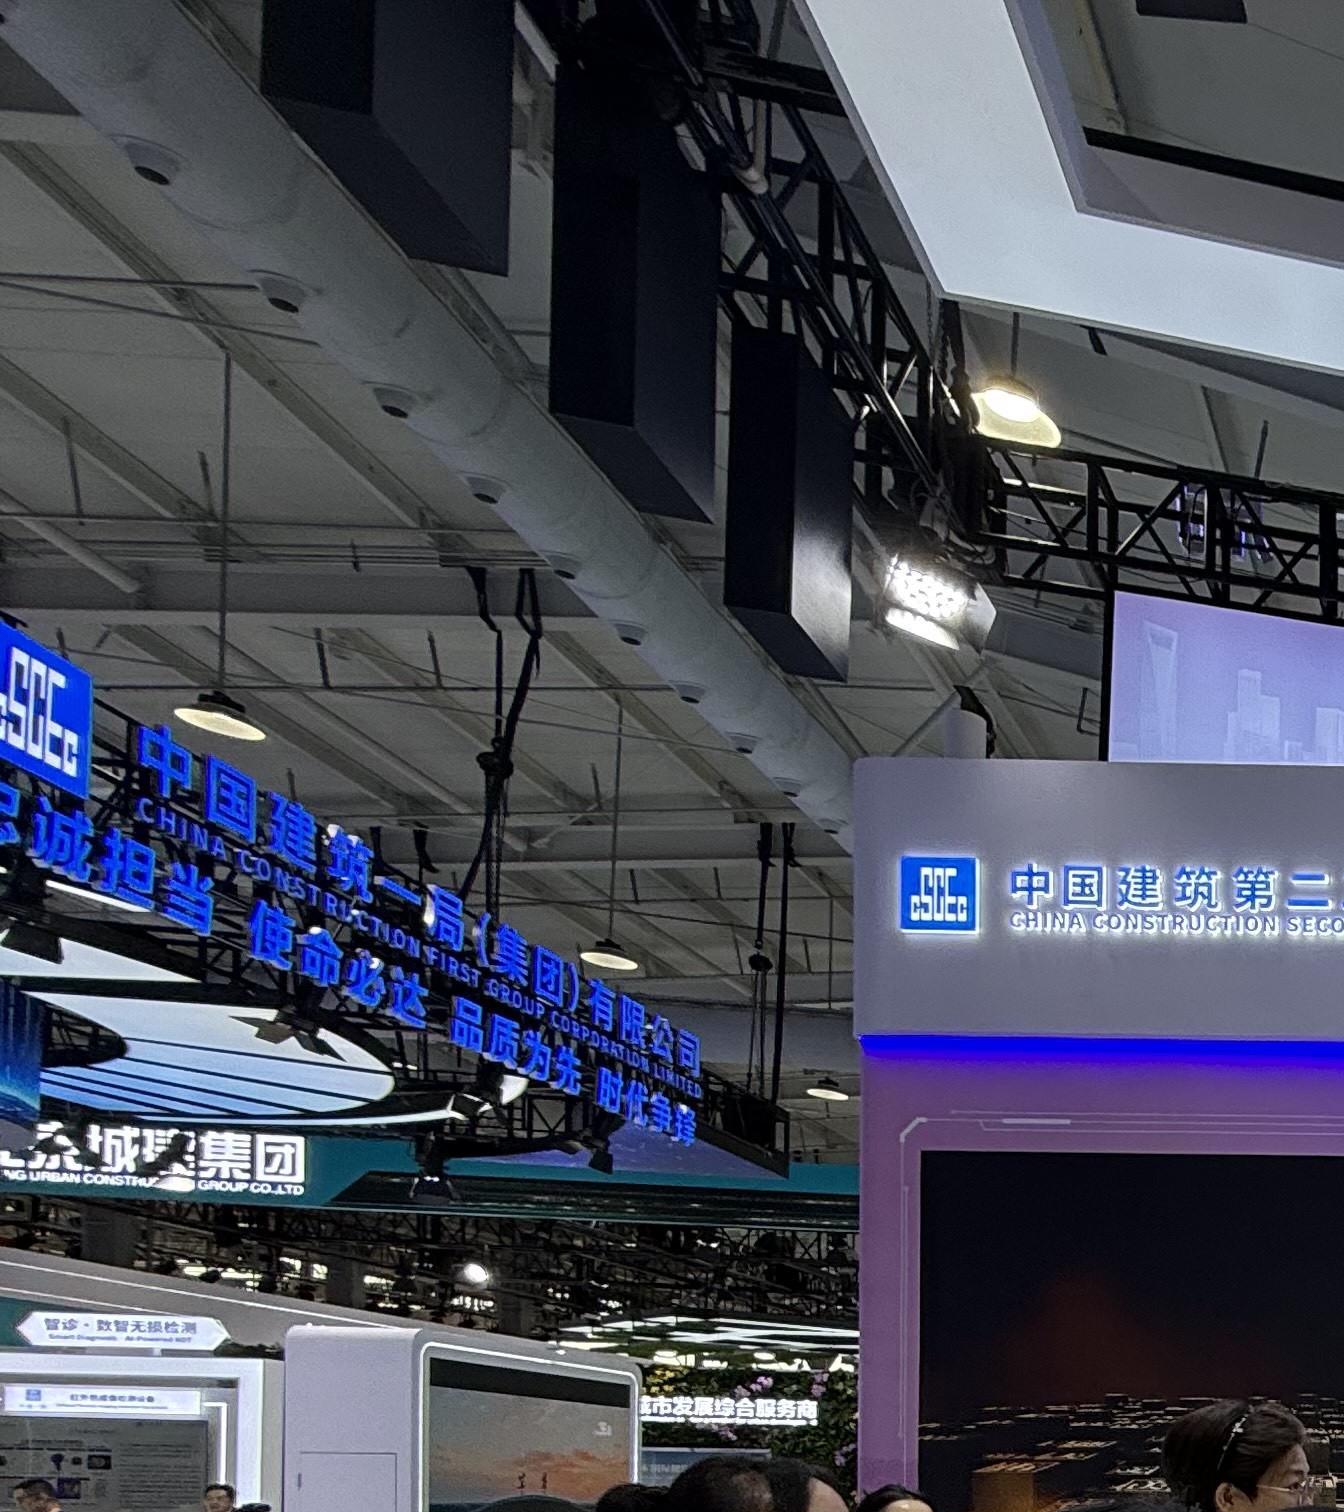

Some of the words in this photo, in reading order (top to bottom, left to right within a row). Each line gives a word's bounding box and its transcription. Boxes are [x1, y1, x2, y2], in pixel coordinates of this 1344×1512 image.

[137, 797, 228, 862] CHINA
[425, 948, 482, 989] FIRST
[486, 978, 546, 1020] GROUP
[653, 1064, 702, 1100] LIMITED
[1010, 910, 1087, 933] CHINA
[1093, 911, 1280, 935] CONSTRUCTION
[248, 899, 429, 1030] 使命必达
[451, 996, 583, 1097] 品质为先
[199, 1180, 250, 1193] GROUP
